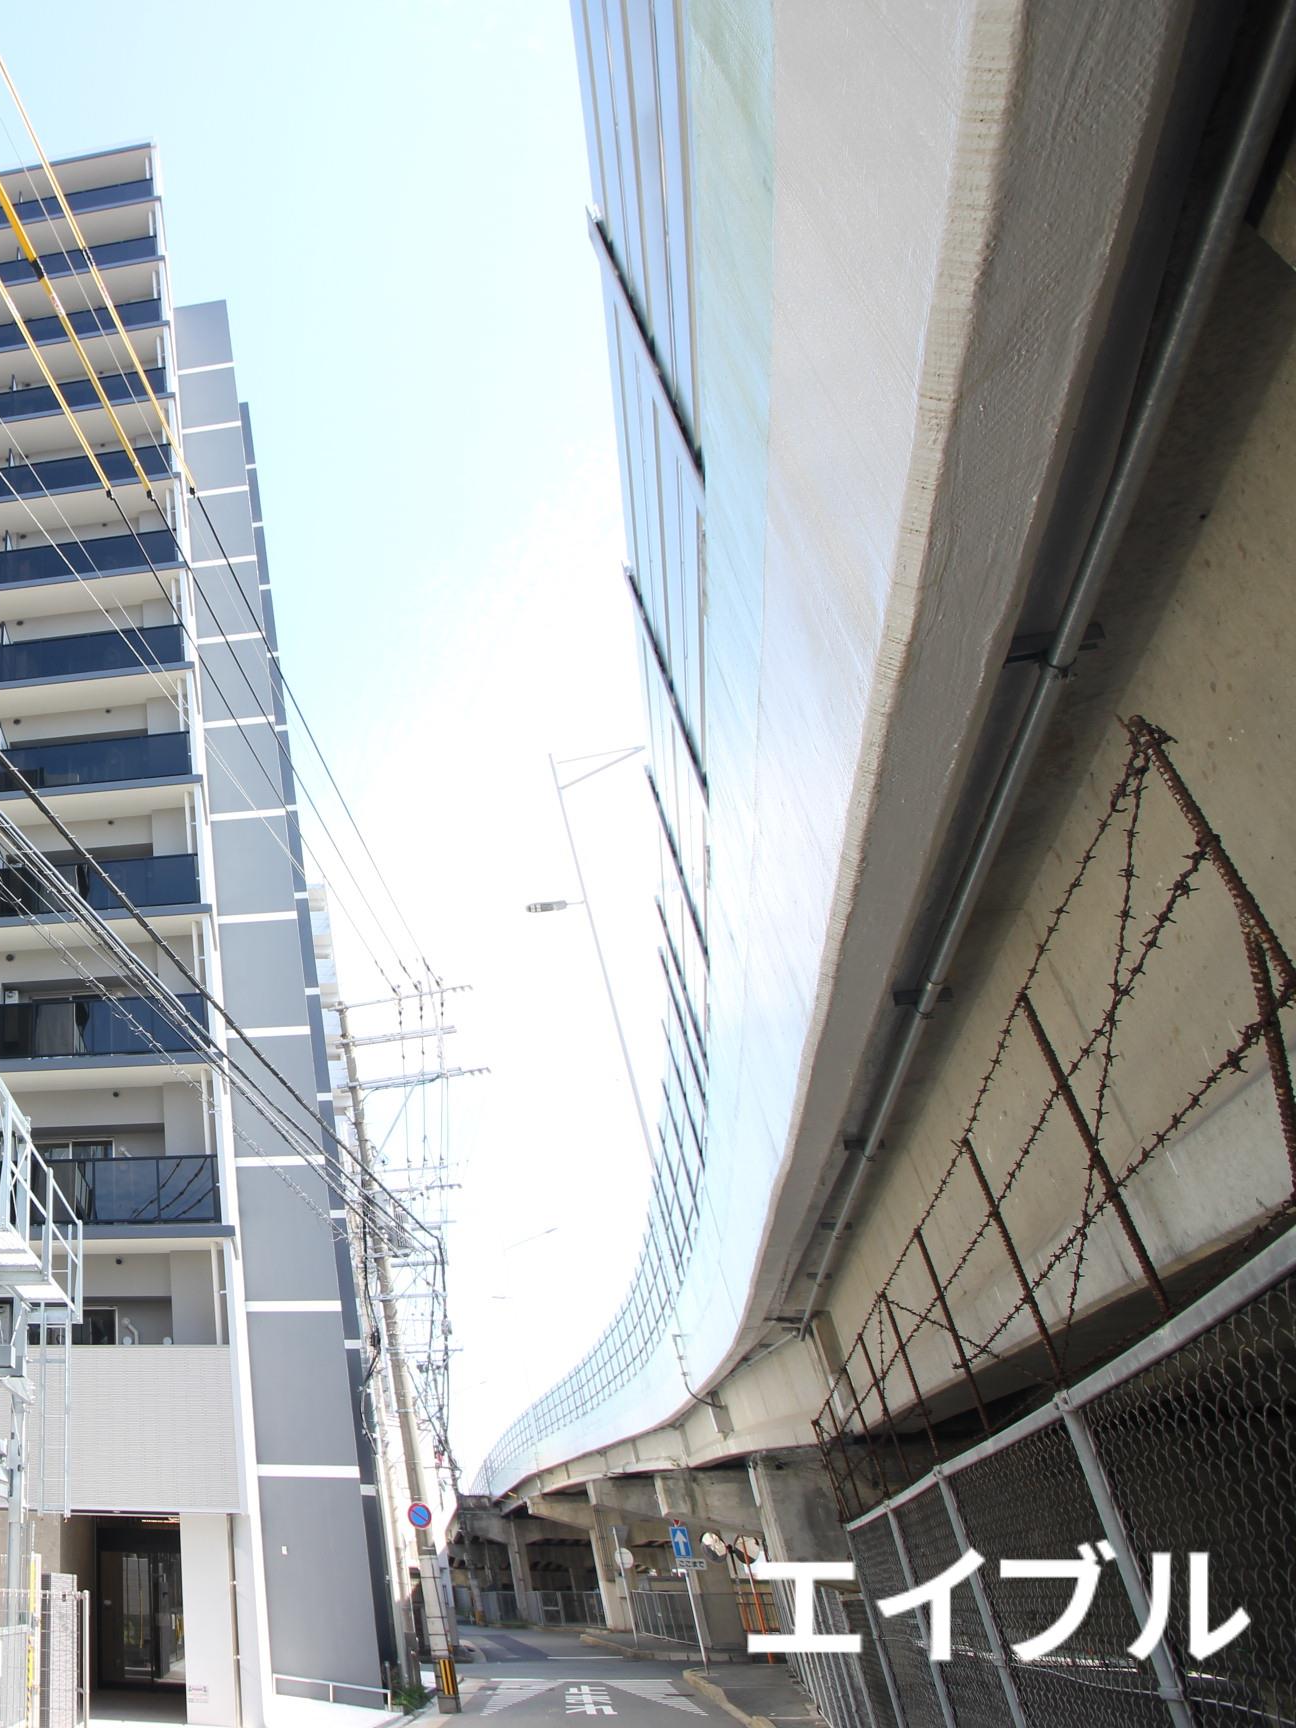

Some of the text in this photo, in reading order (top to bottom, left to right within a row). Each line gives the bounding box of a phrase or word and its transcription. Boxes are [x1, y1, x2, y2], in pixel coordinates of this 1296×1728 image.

[679, 1560, 705, 1568] ここまで
[564, 1685, 618, 1715] 止まれ
